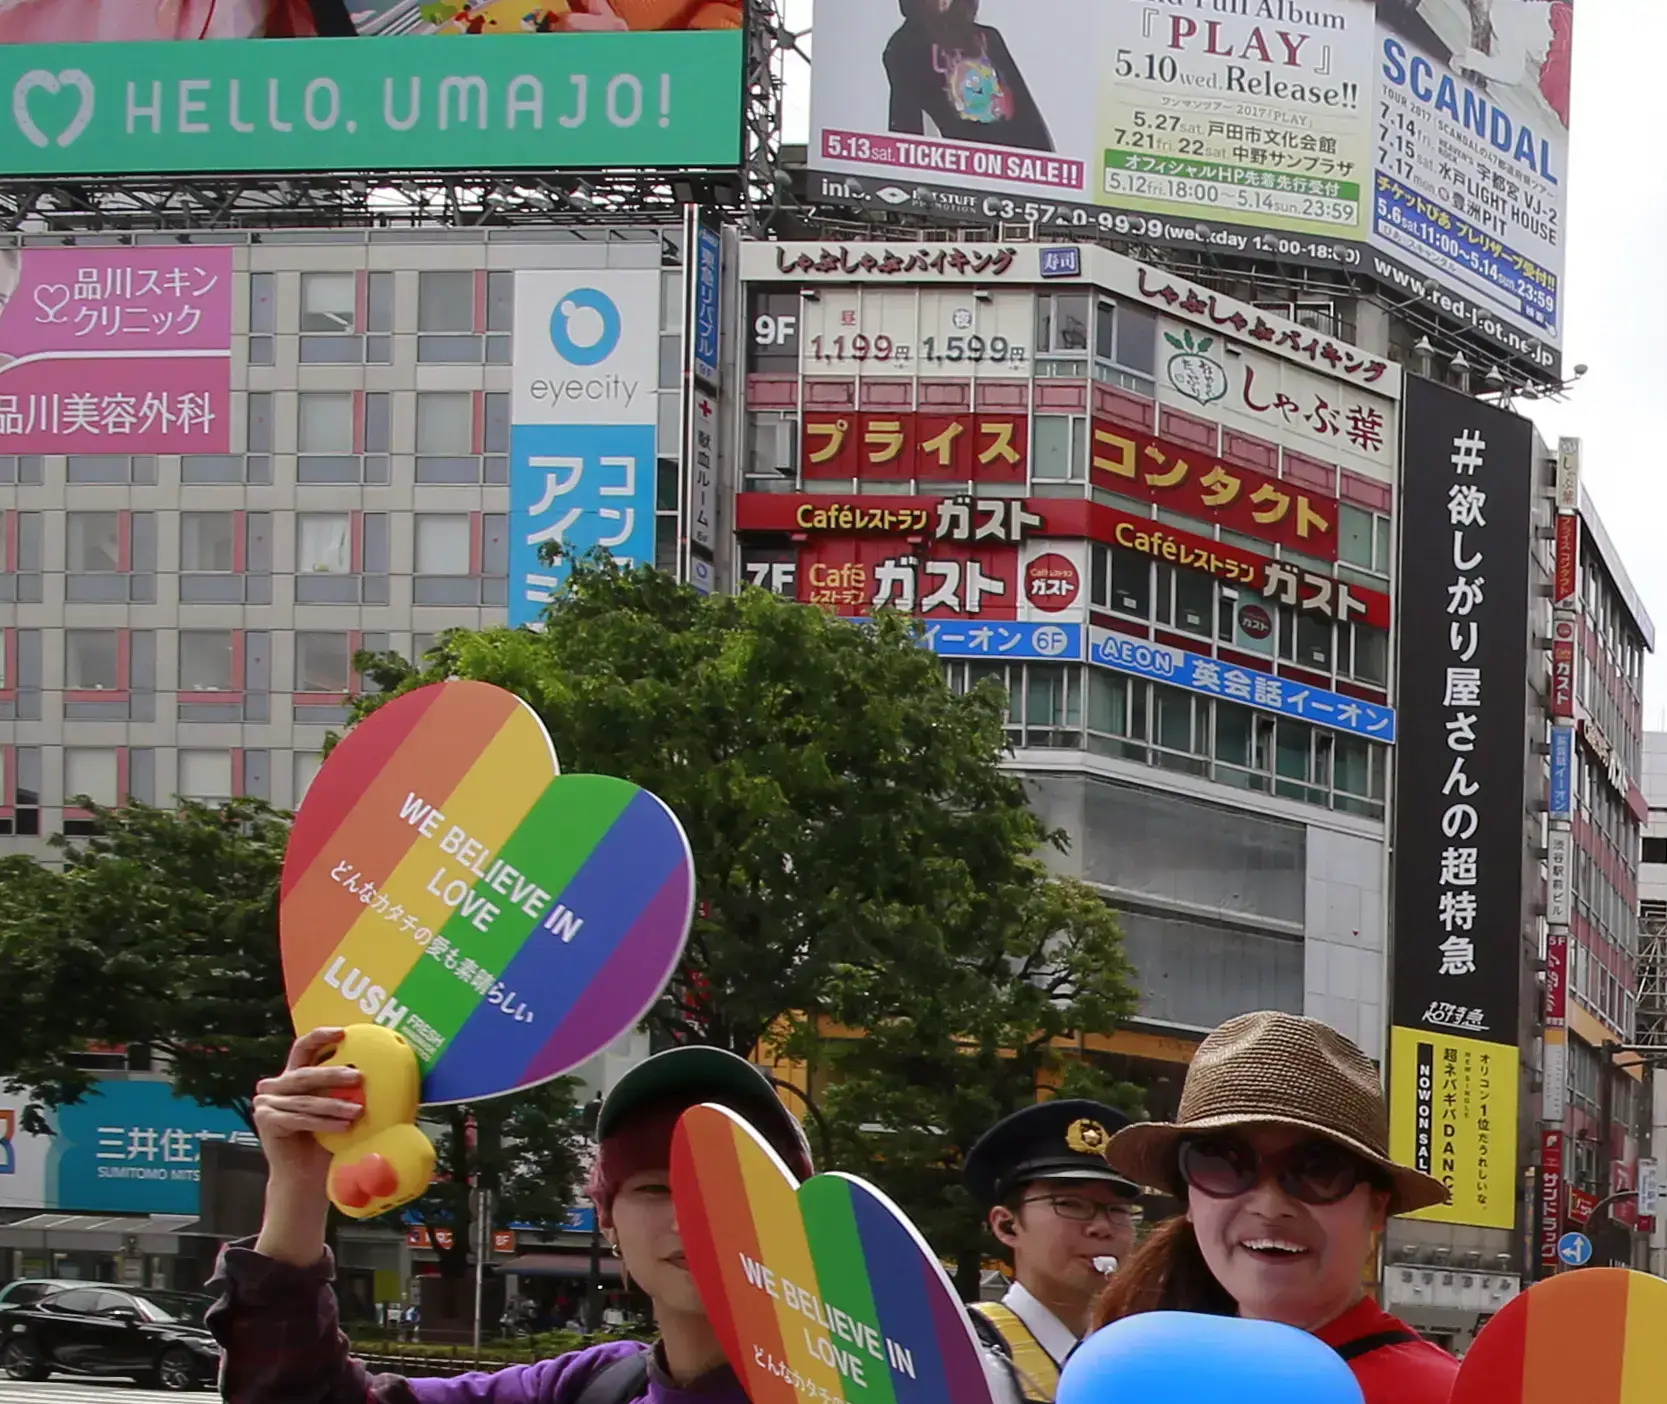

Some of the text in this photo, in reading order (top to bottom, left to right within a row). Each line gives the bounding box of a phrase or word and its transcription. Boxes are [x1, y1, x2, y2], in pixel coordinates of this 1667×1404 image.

[1256, 0, 1345, 30] Album
[125, 72, 674, 135] HELLO, UMAJO!
[1382, 38, 1559, 187] SCANDAL
[1207, 120, 1338, 155] 戸田市文化会館
[896, 141, 968, 171] TICKET
[973, 151, 1002, 175] ON
[1008, 157, 1078, 185] SALE!!
[1232, 146, 1354, 178] 中野サンプラザ
[1511, 207, 1558, 246] HOUSE
[1523, 190, 1558, 226] VJ-2
[73, 265, 219, 299] 品川スキン
[775, 245, 1075, 277] しゃぶしゃぶバイキング 寿司
[73, 304, 203, 337] クリニック
[754, 314, 796, 346] 9F
[1137, 266, 1389, 383] しゃぶしゃぶバイキング
[0, 390, 216, 438] 品川美容外科
[529, 374, 639, 409] eyecity
[1243, 363, 1385, 453] しゃぶ葉
[806, 417, 1023, 467] プライス
[1092, 427, 1331, 539] コンタクト
[935, 495, 1042, 542] ガスト
[526, 456, 584, 634] アイ
[746, 562, 796, 598] 7F
[872, 555, 1005, 614] ガスト
[1031, 579, 1075, 597] ガスト
[1262, 558, 1367, 622] ガスト
[1035, 631, 1063, 651] 6F
[1101, 638, 1173, 674] AEON
[1555, 660, 1571, 706] ガスト
[398, 791, 585, 946] WE BELIEVE IN
[426, 867, 501, 934] LOVE
[330, 859, 536, 1026] どんなカタチの愛も素晴らしい
[1548, 935, 1566, 947] 5F
[323, 955, 410, 1031] LUSH
[1417, 1063, 1432, 1174] NOW ON SAL
[97, 1166, 168, 1181] SUMITOMO
[738, 1251, 917, 1381] WE BELIEVE IN
[804, 1327, 868, 1389] LOVE
